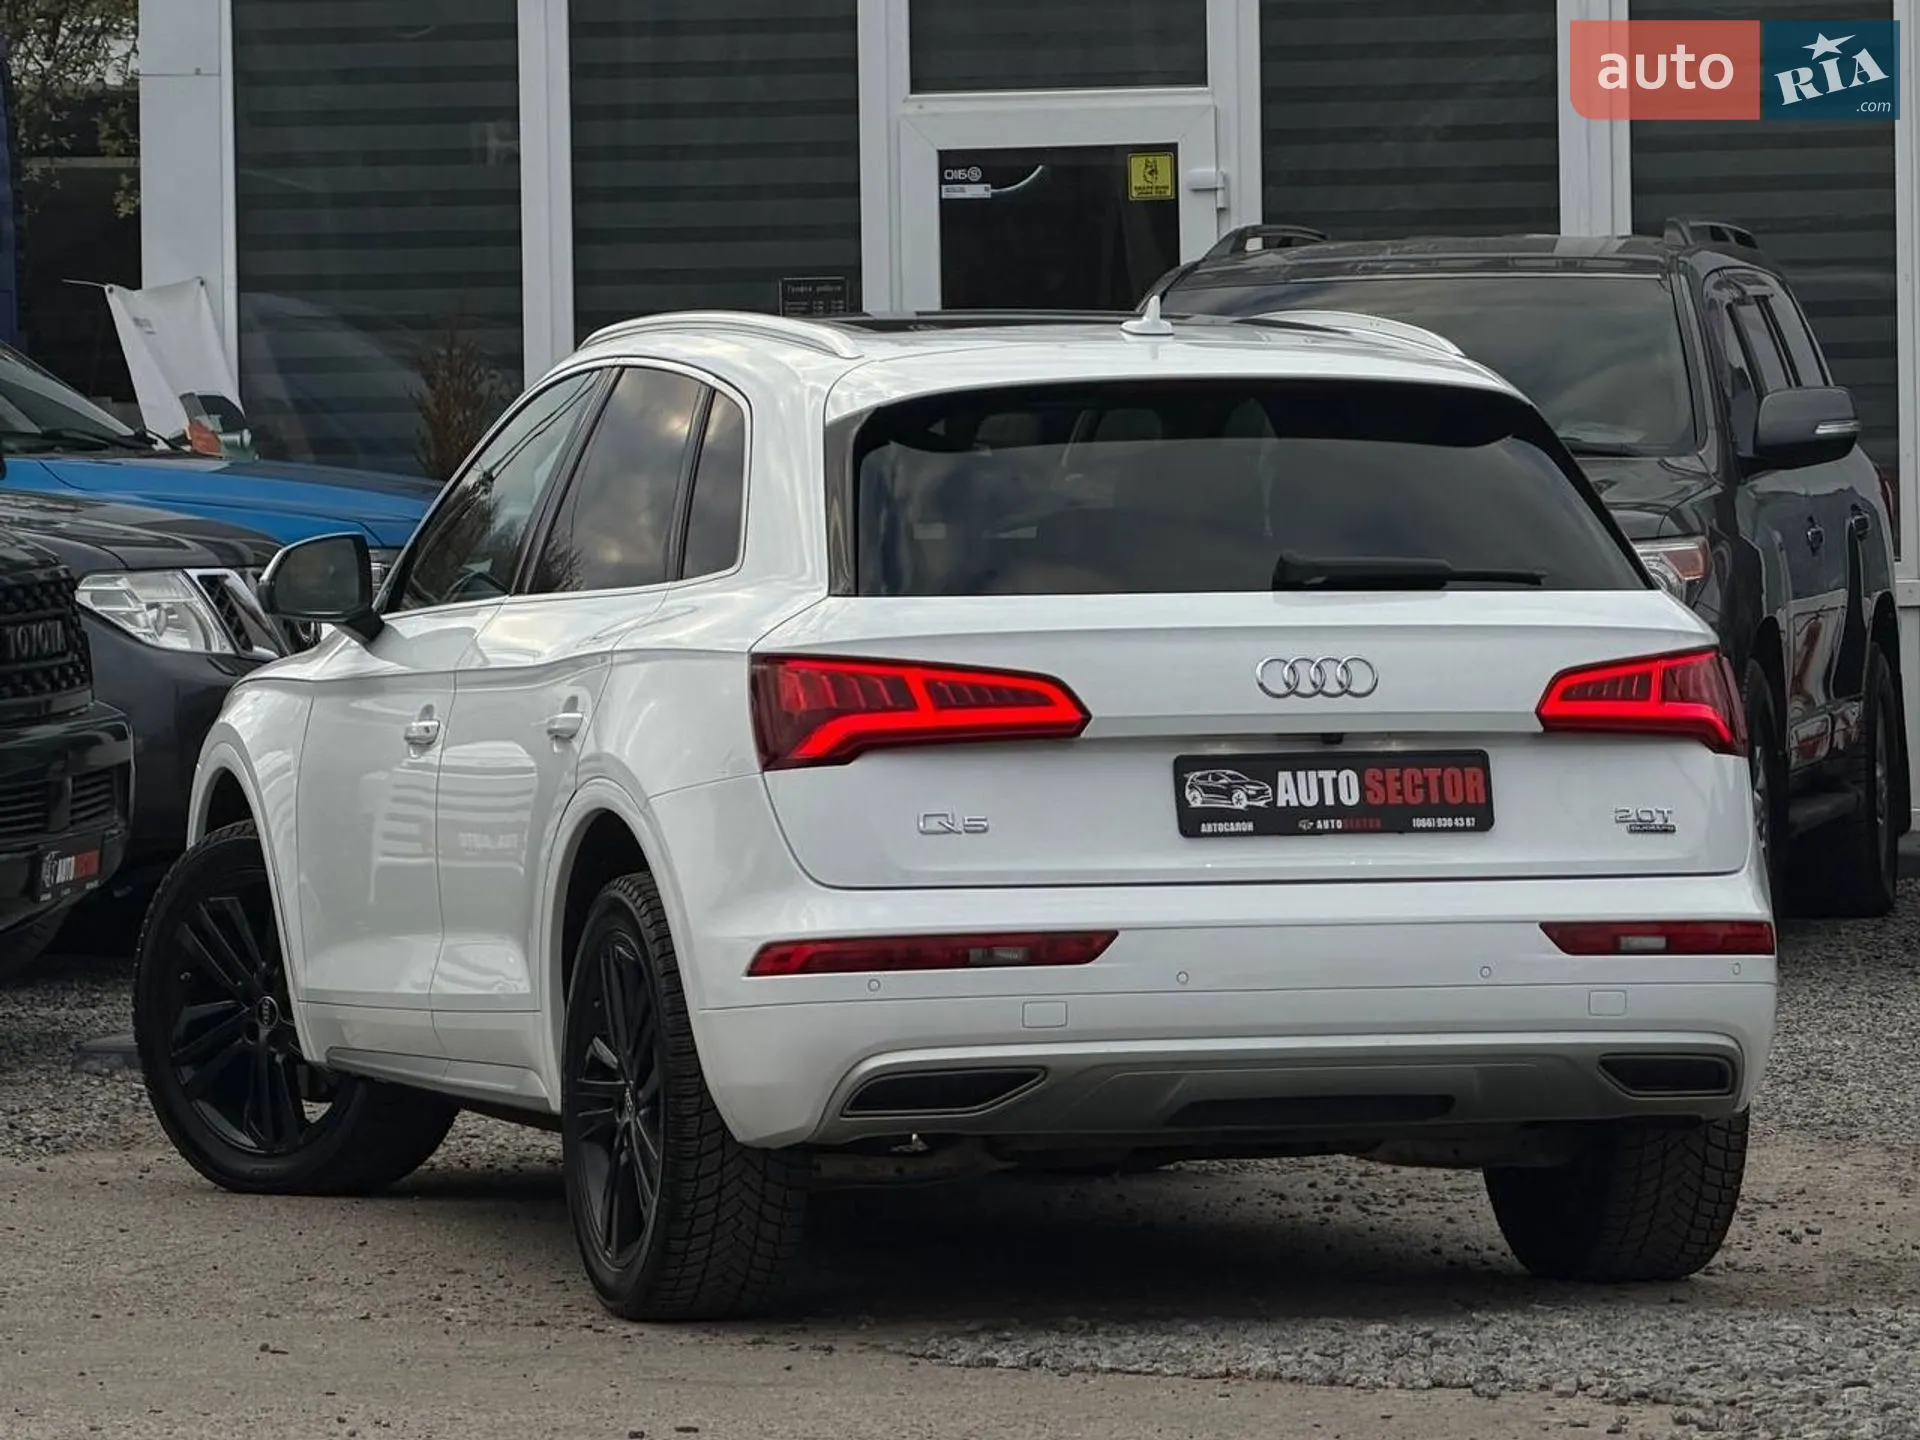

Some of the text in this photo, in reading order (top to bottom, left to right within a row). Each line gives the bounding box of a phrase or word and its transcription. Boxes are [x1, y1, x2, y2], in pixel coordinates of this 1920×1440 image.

[1276, 767, 1486, 807] AUTO SECTOR
[917, 811, 989, 836] Q5
